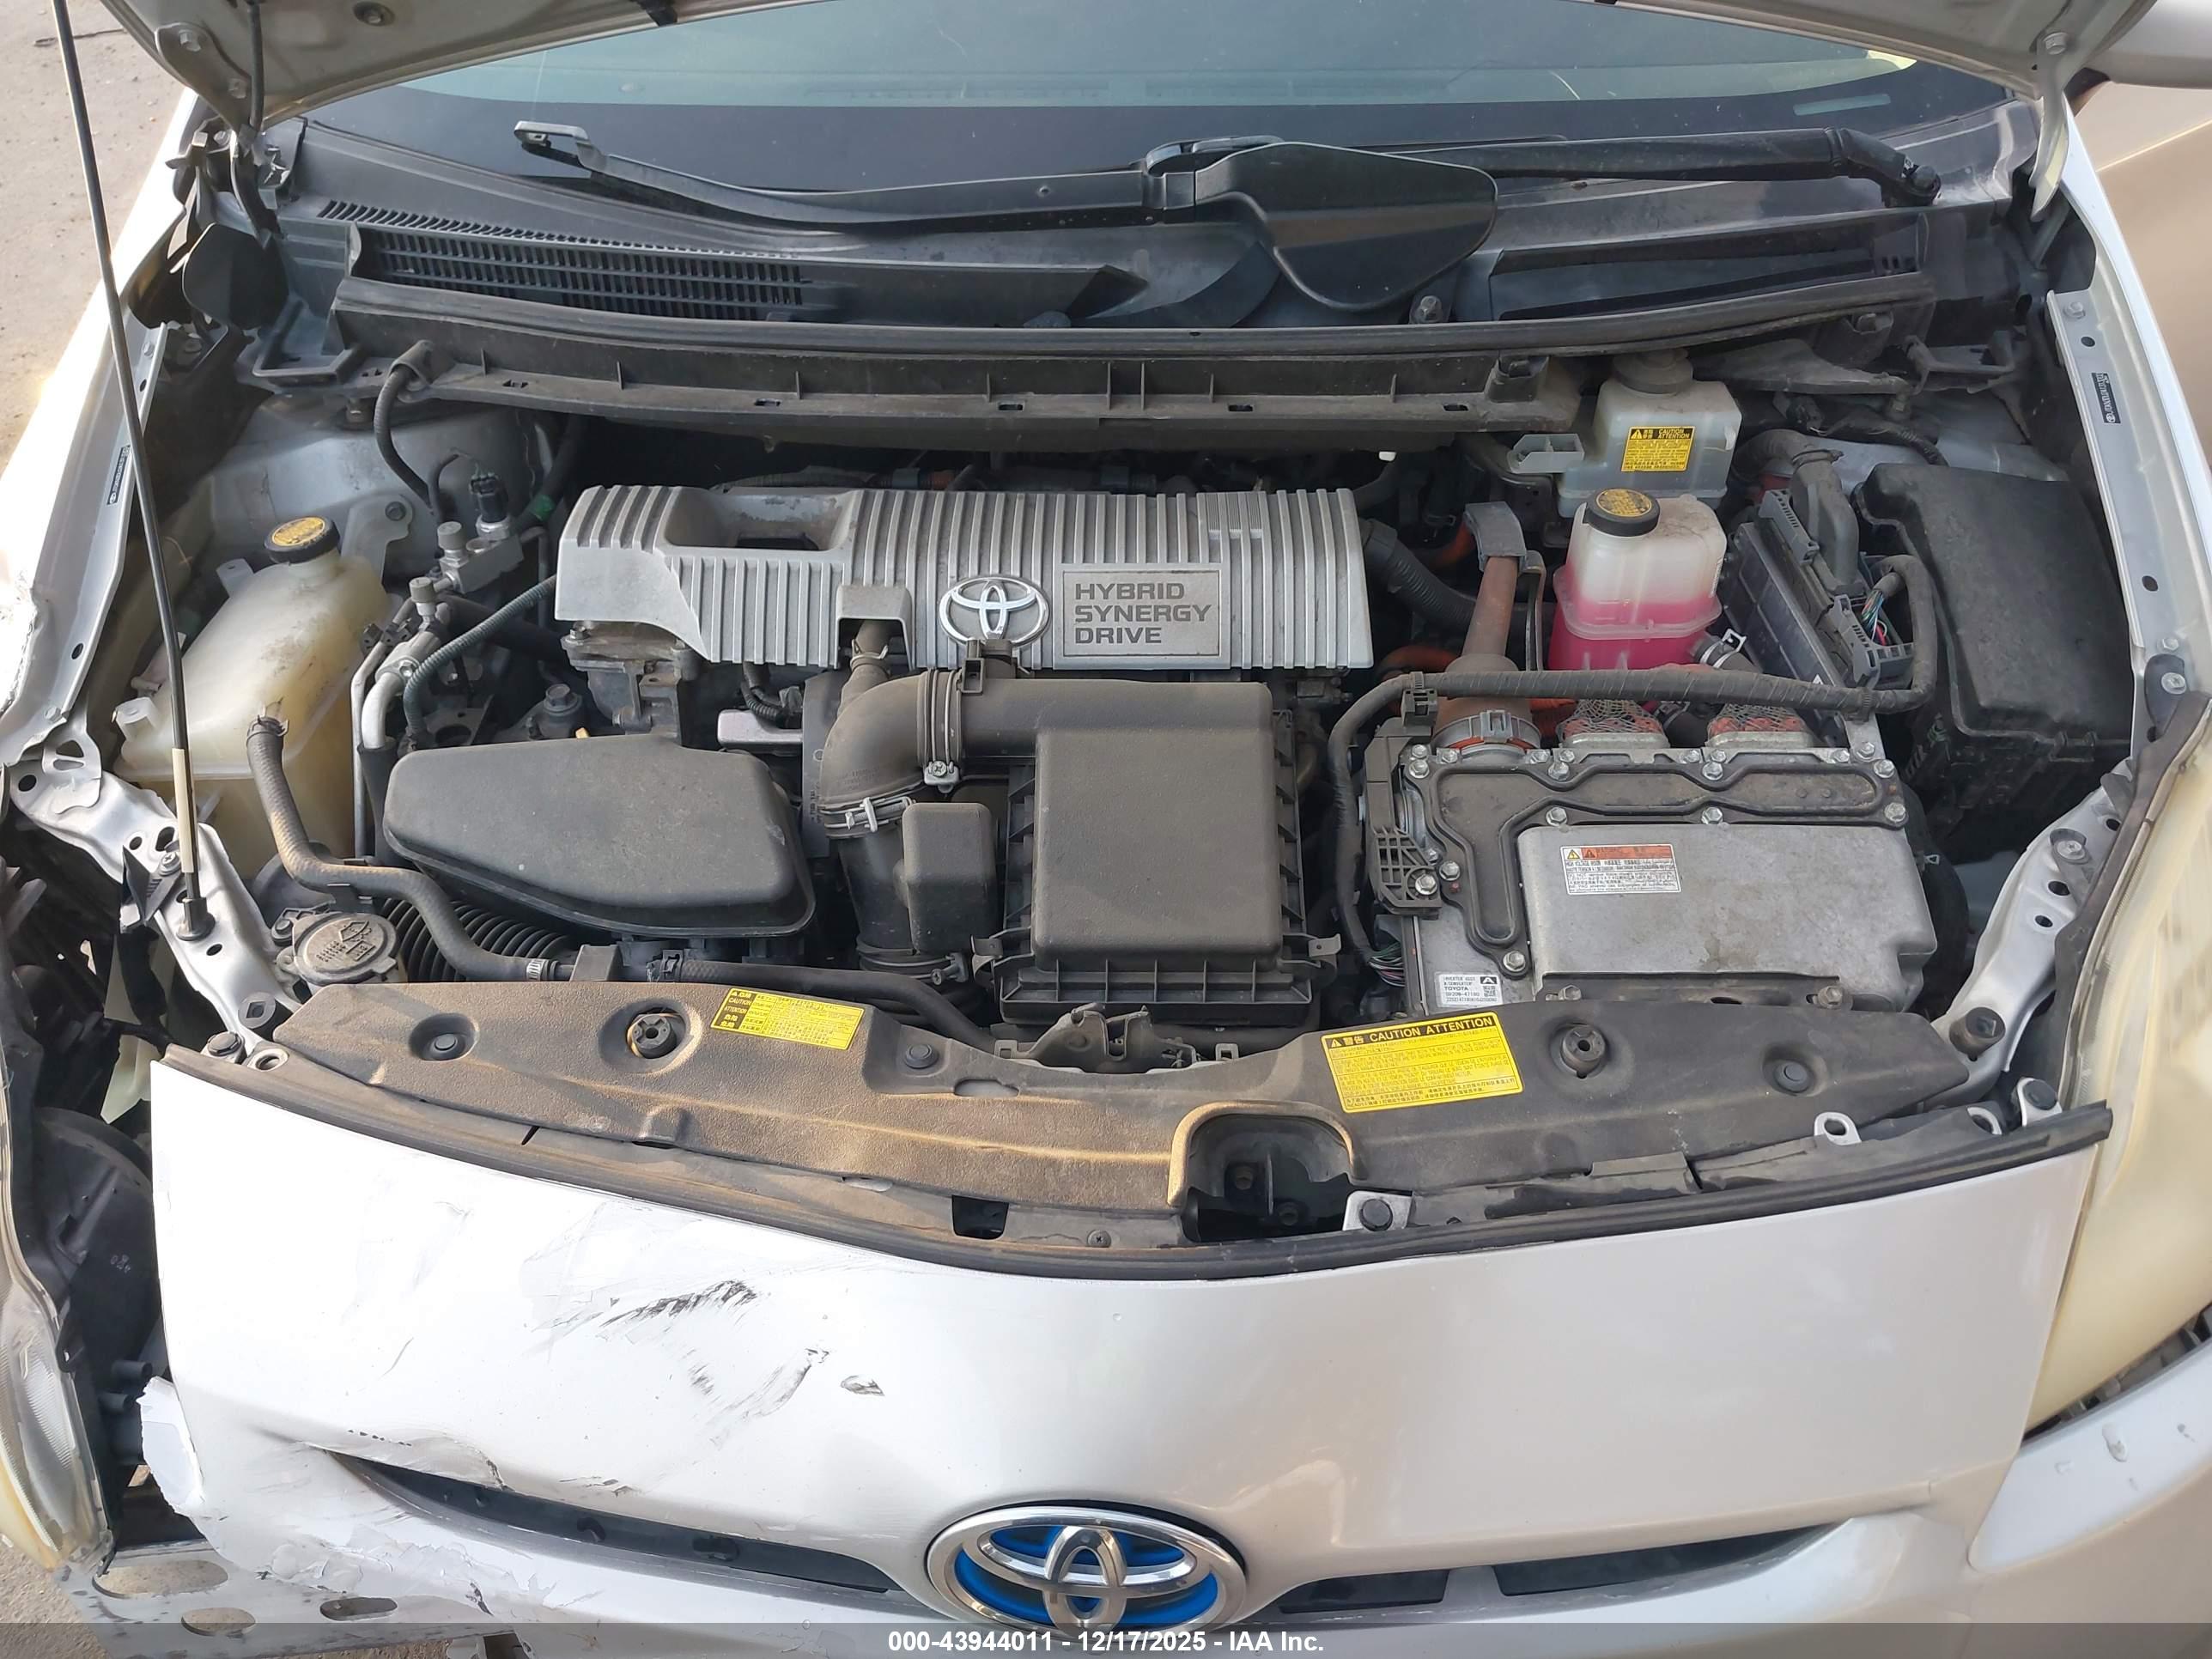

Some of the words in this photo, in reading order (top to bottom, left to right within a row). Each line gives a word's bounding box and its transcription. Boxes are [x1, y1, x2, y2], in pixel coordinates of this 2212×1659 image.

[1075, 583, 1185, 599] HYBRID
[1074, 605, 1212, 622] SYNERGY
[1075, 627, 1162, 644] DRIVE
[728, 997, 752, 1006] CAUTION
[1370, 1027, 1421, 1042] CAUTION
[1426, 1017, 1492, 1034] ATTENTION
